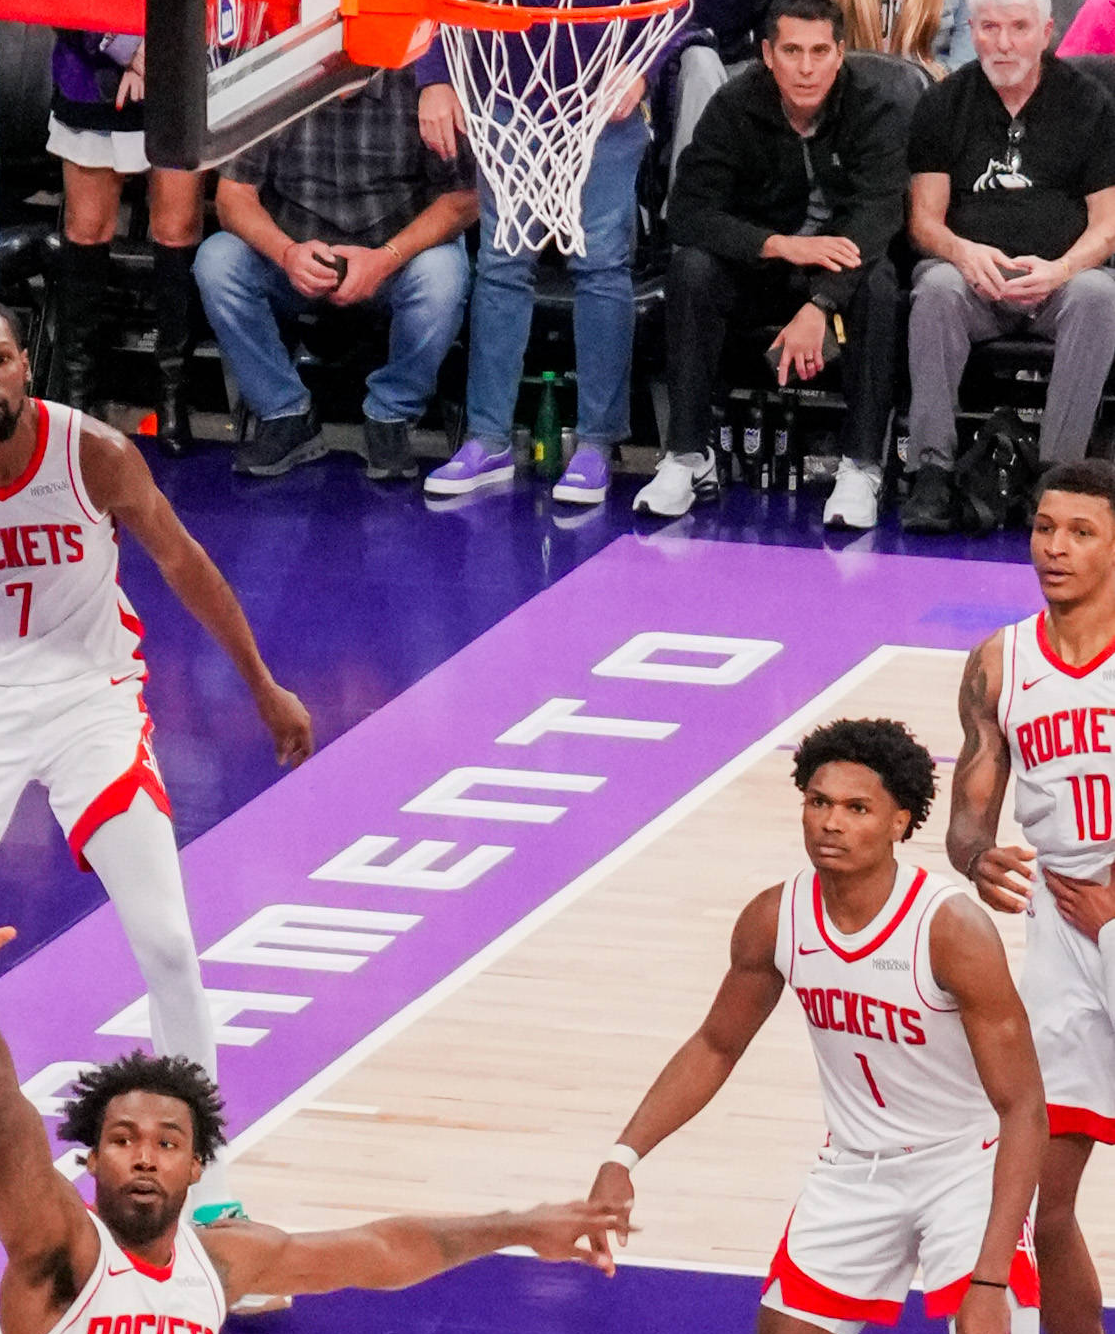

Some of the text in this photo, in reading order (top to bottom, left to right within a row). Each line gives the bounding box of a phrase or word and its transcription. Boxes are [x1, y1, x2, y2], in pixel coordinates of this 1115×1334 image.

[5, 581, 33, 638] 7
[1066, 774, 1112, 841] 10
[796, 986, 926, 1046] ROCKETS
[853, 1052, 886, 1108] 1
